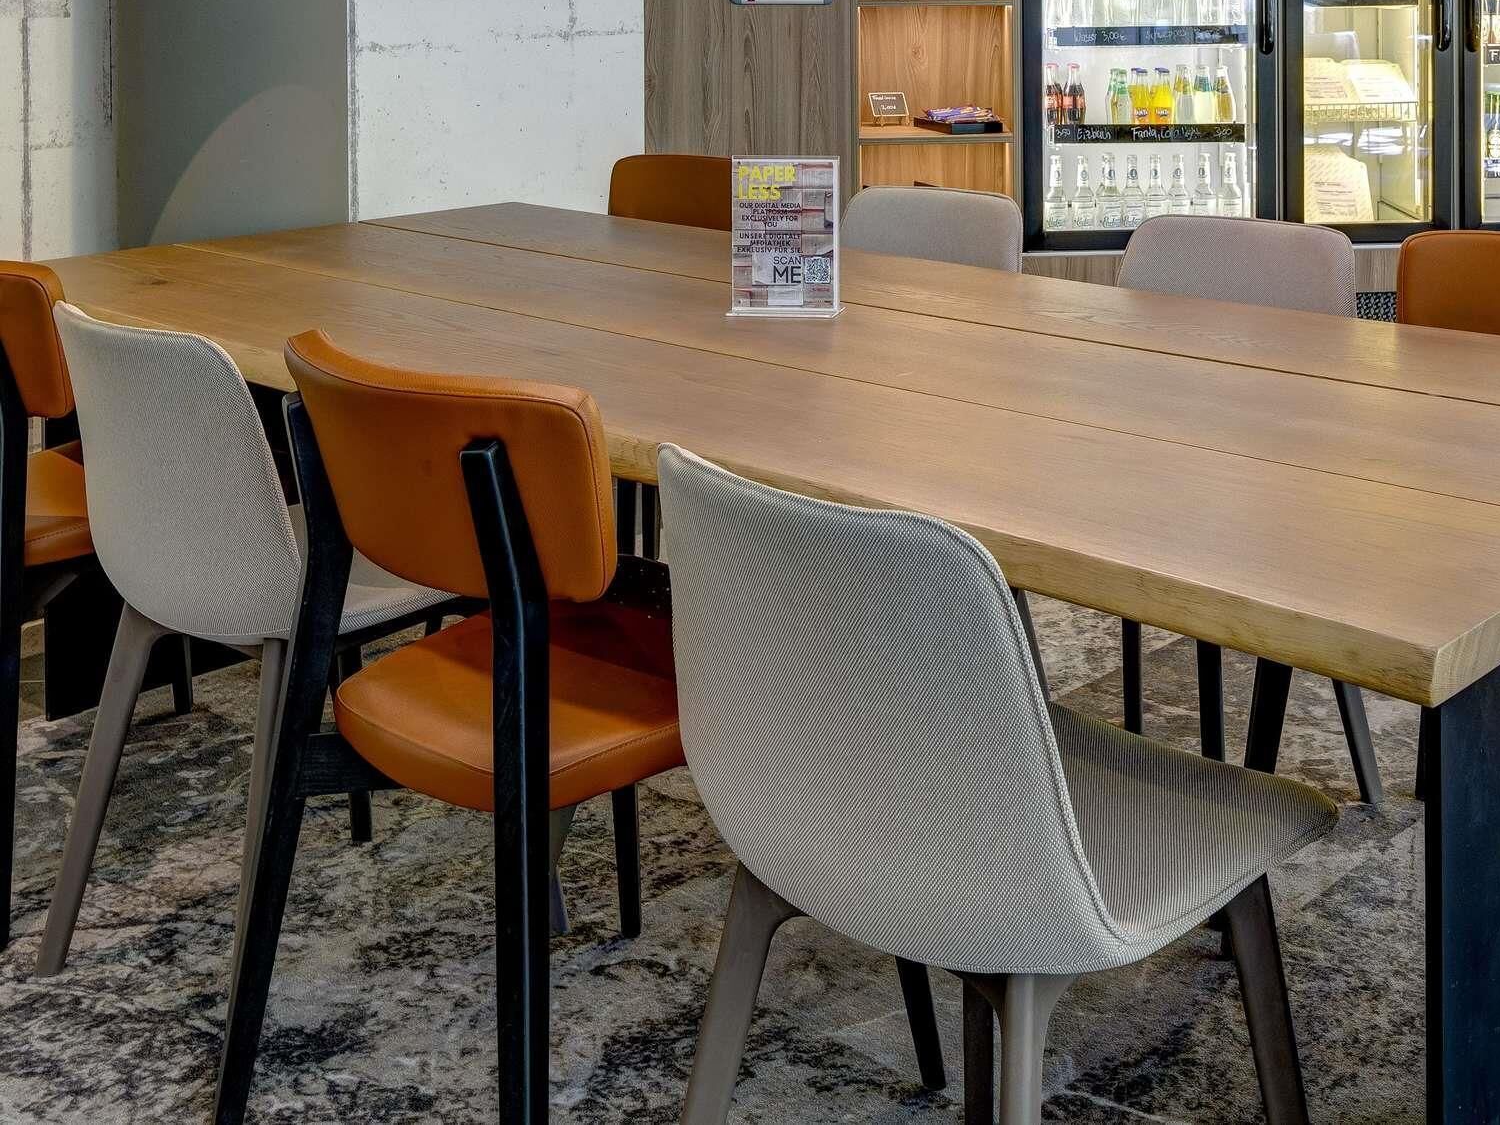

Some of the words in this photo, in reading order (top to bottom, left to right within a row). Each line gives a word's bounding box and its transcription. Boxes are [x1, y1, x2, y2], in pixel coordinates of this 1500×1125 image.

[738, 165, 796, 181] PAPER
[738, 184, 781, 200] LESS
[773, 256, 801, 265] SCAN
[773, 266, 801, 283] ME
